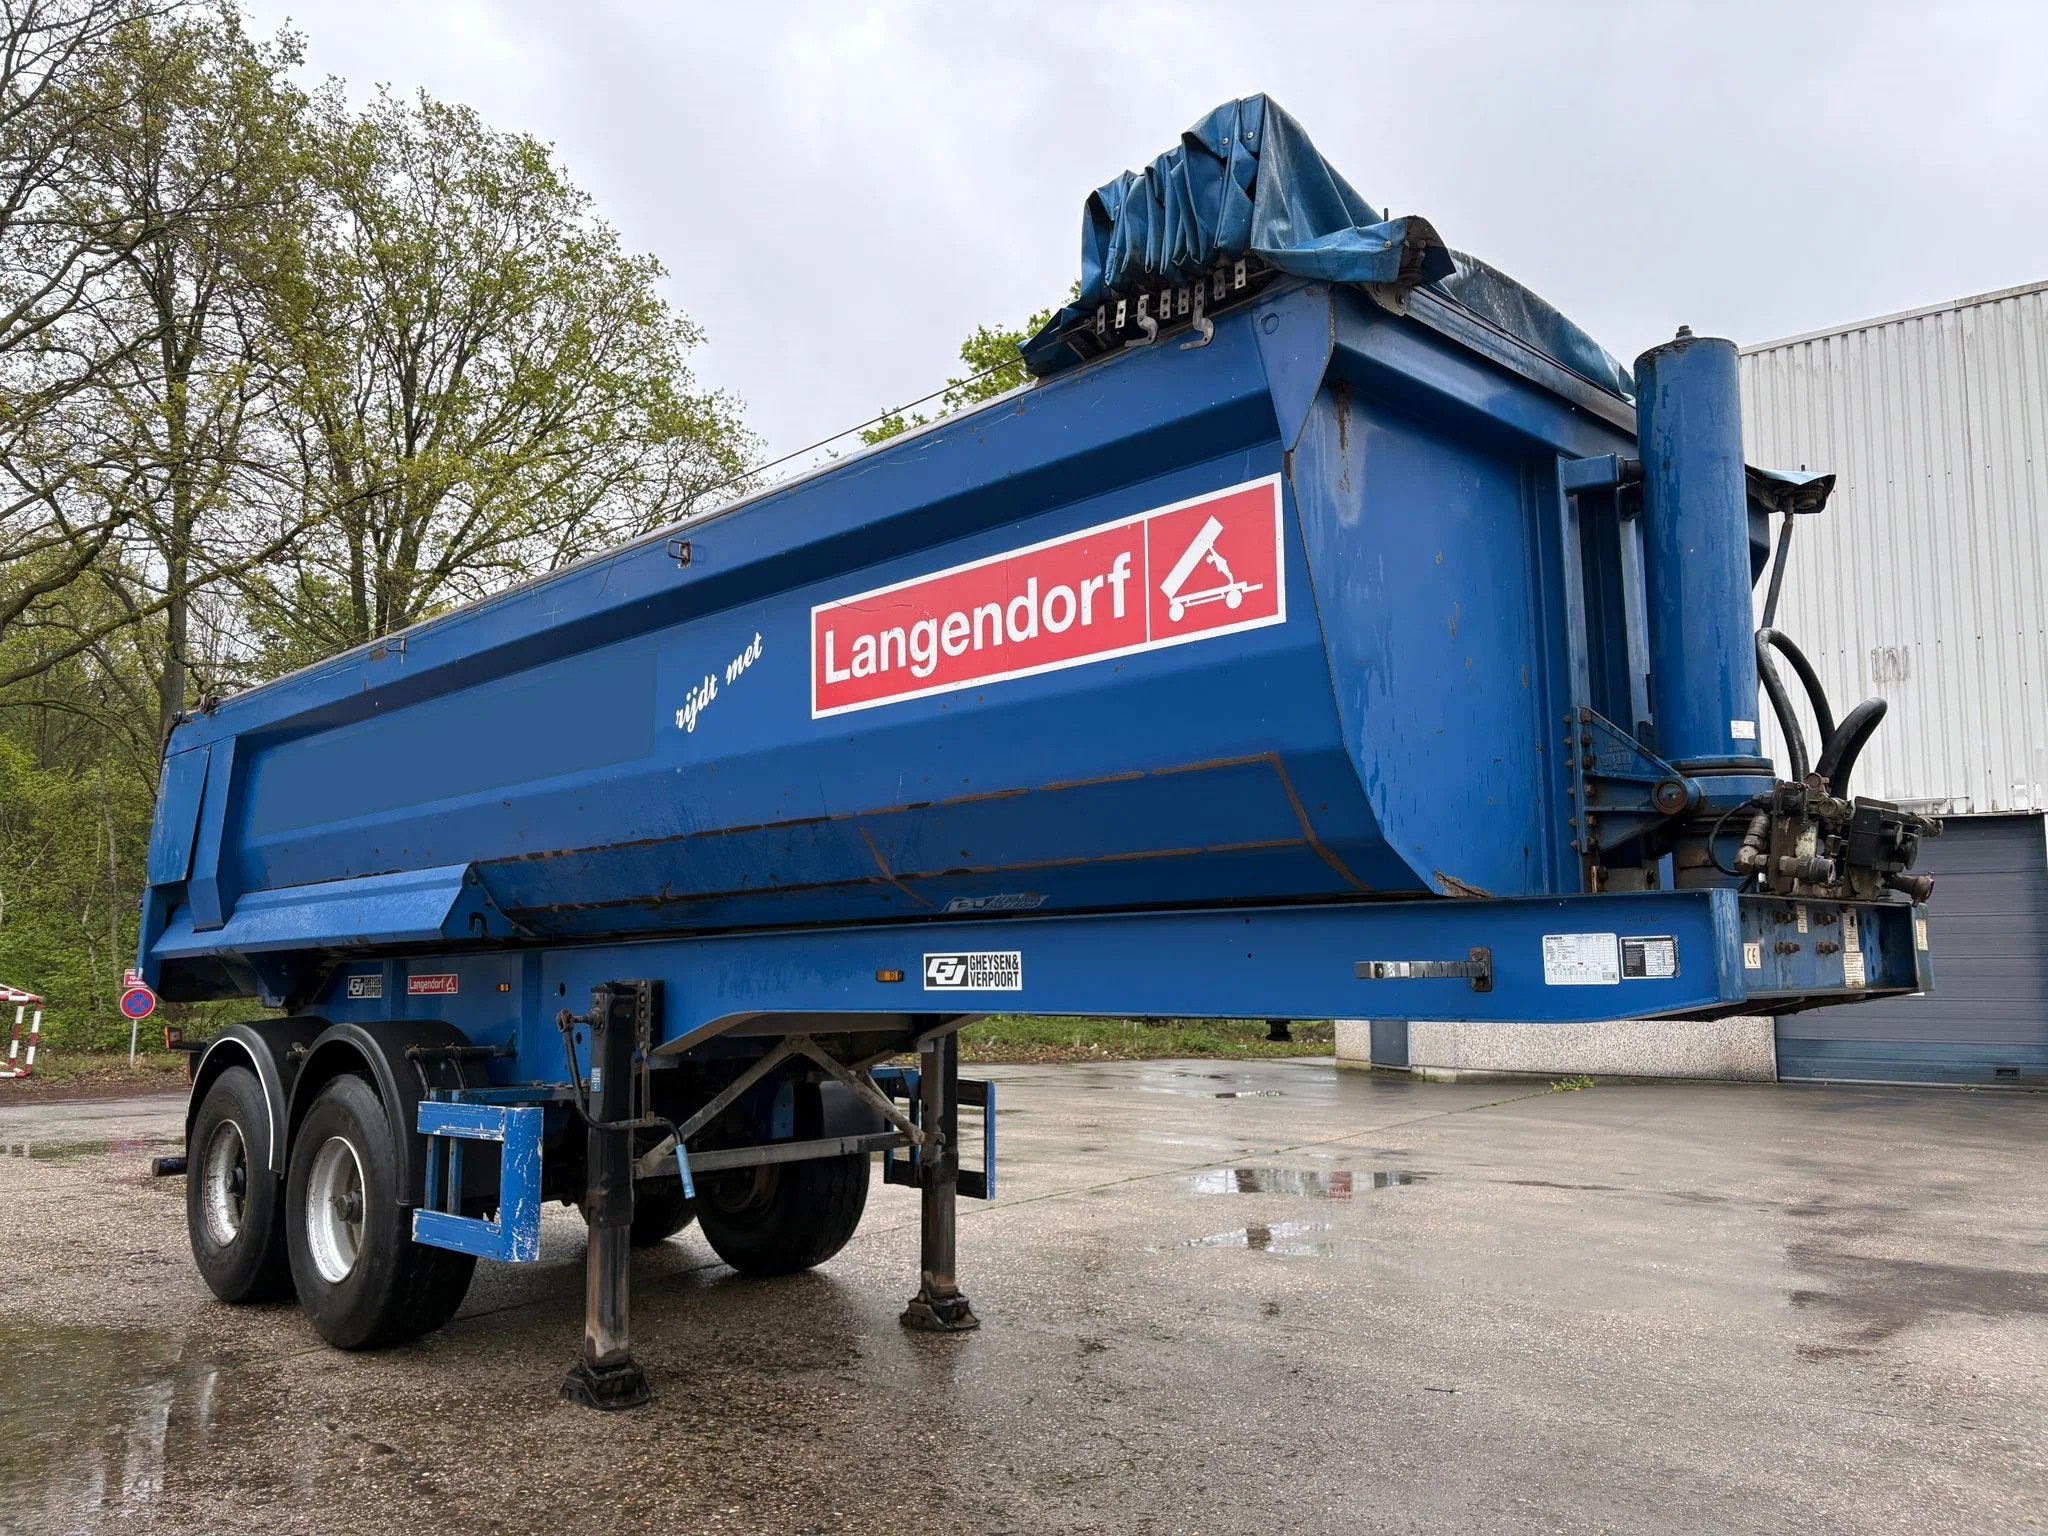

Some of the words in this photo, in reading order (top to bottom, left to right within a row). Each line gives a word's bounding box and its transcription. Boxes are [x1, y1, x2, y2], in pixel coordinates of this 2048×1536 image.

[824, 551, 1132, 684] Langendorf
[675, 673, 718, 733] rijdt
[725, 631, 763, 686] met
[969, 954, 1019, 971] GHEYSEN&
[409, 978, 445, 992] Langendorf
[970, 971, 1019, 987] VERPOORT
